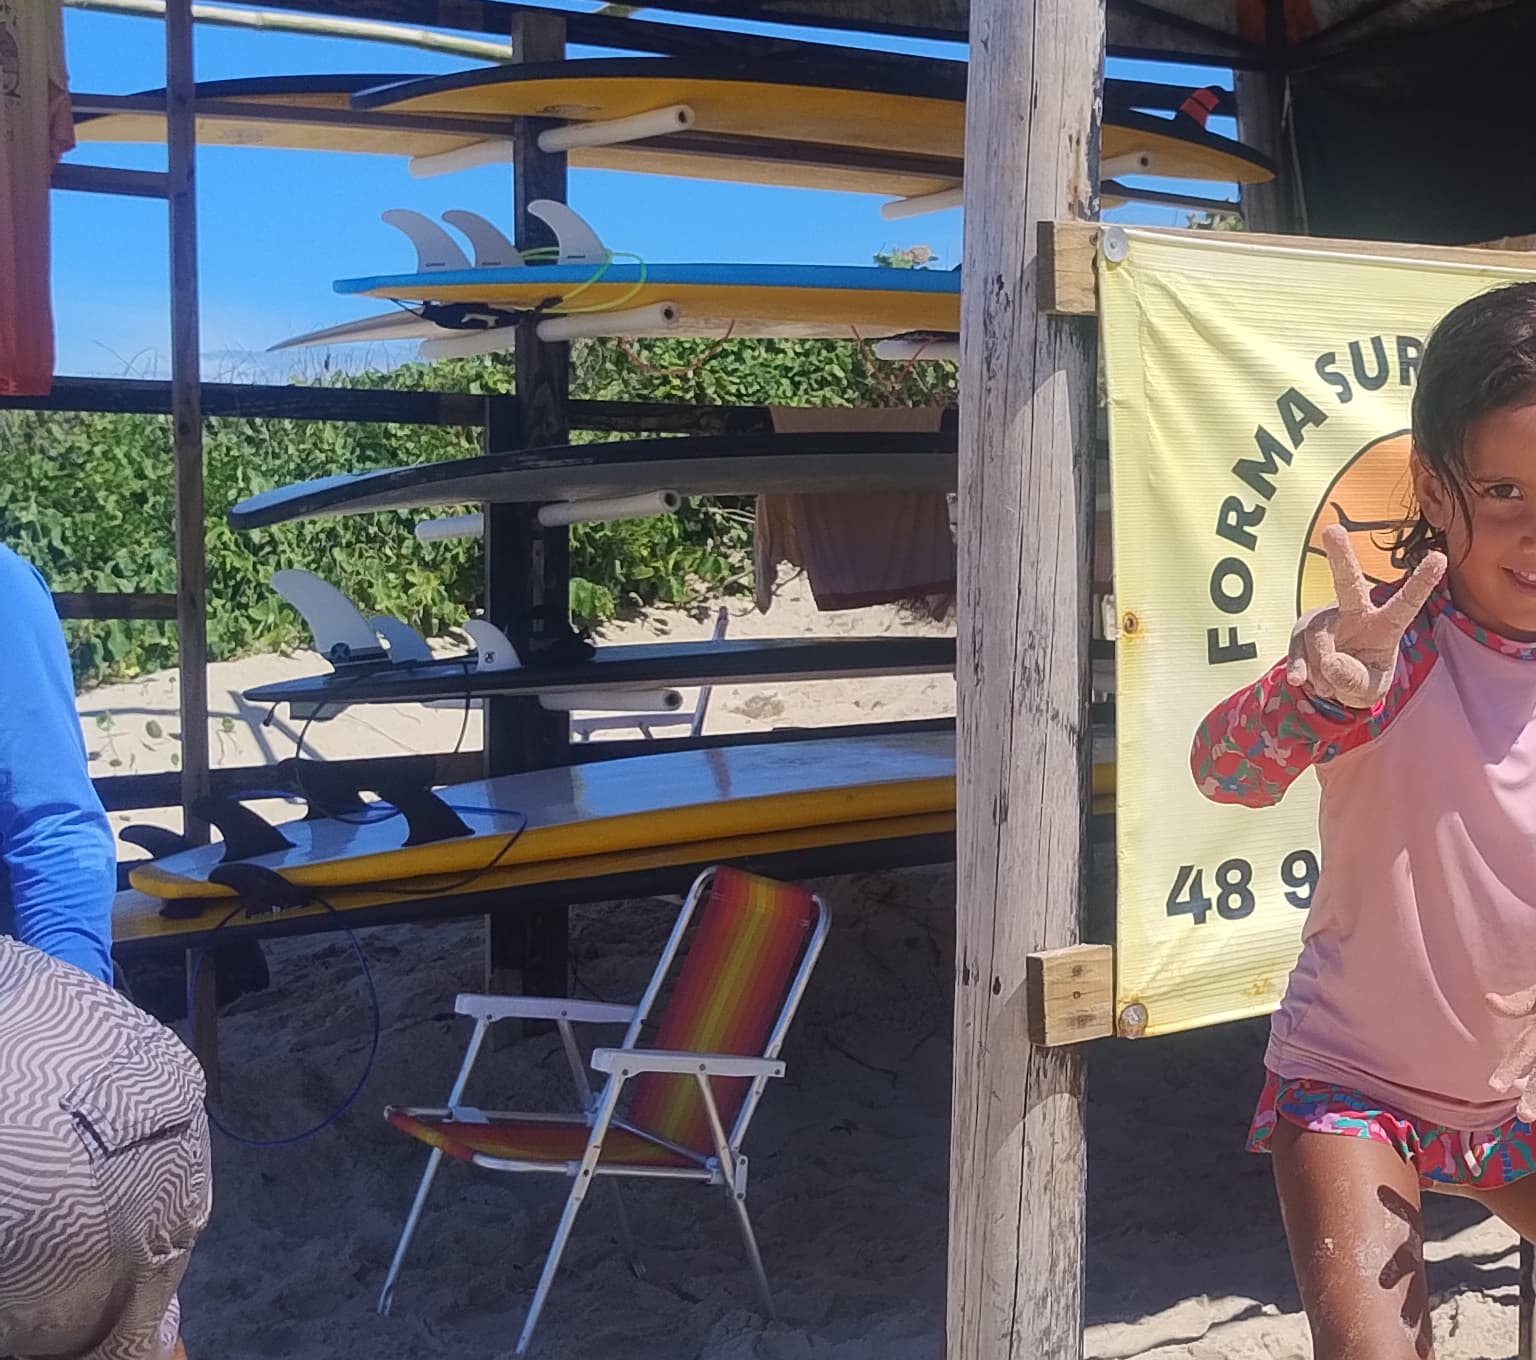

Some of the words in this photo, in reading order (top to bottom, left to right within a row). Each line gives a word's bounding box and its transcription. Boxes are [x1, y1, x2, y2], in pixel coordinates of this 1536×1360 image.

[1207, 386, 1328, 665] FORMA
[1315, 335, 1424, 404] SUR
[1165, 857, 1256, 926] 48
